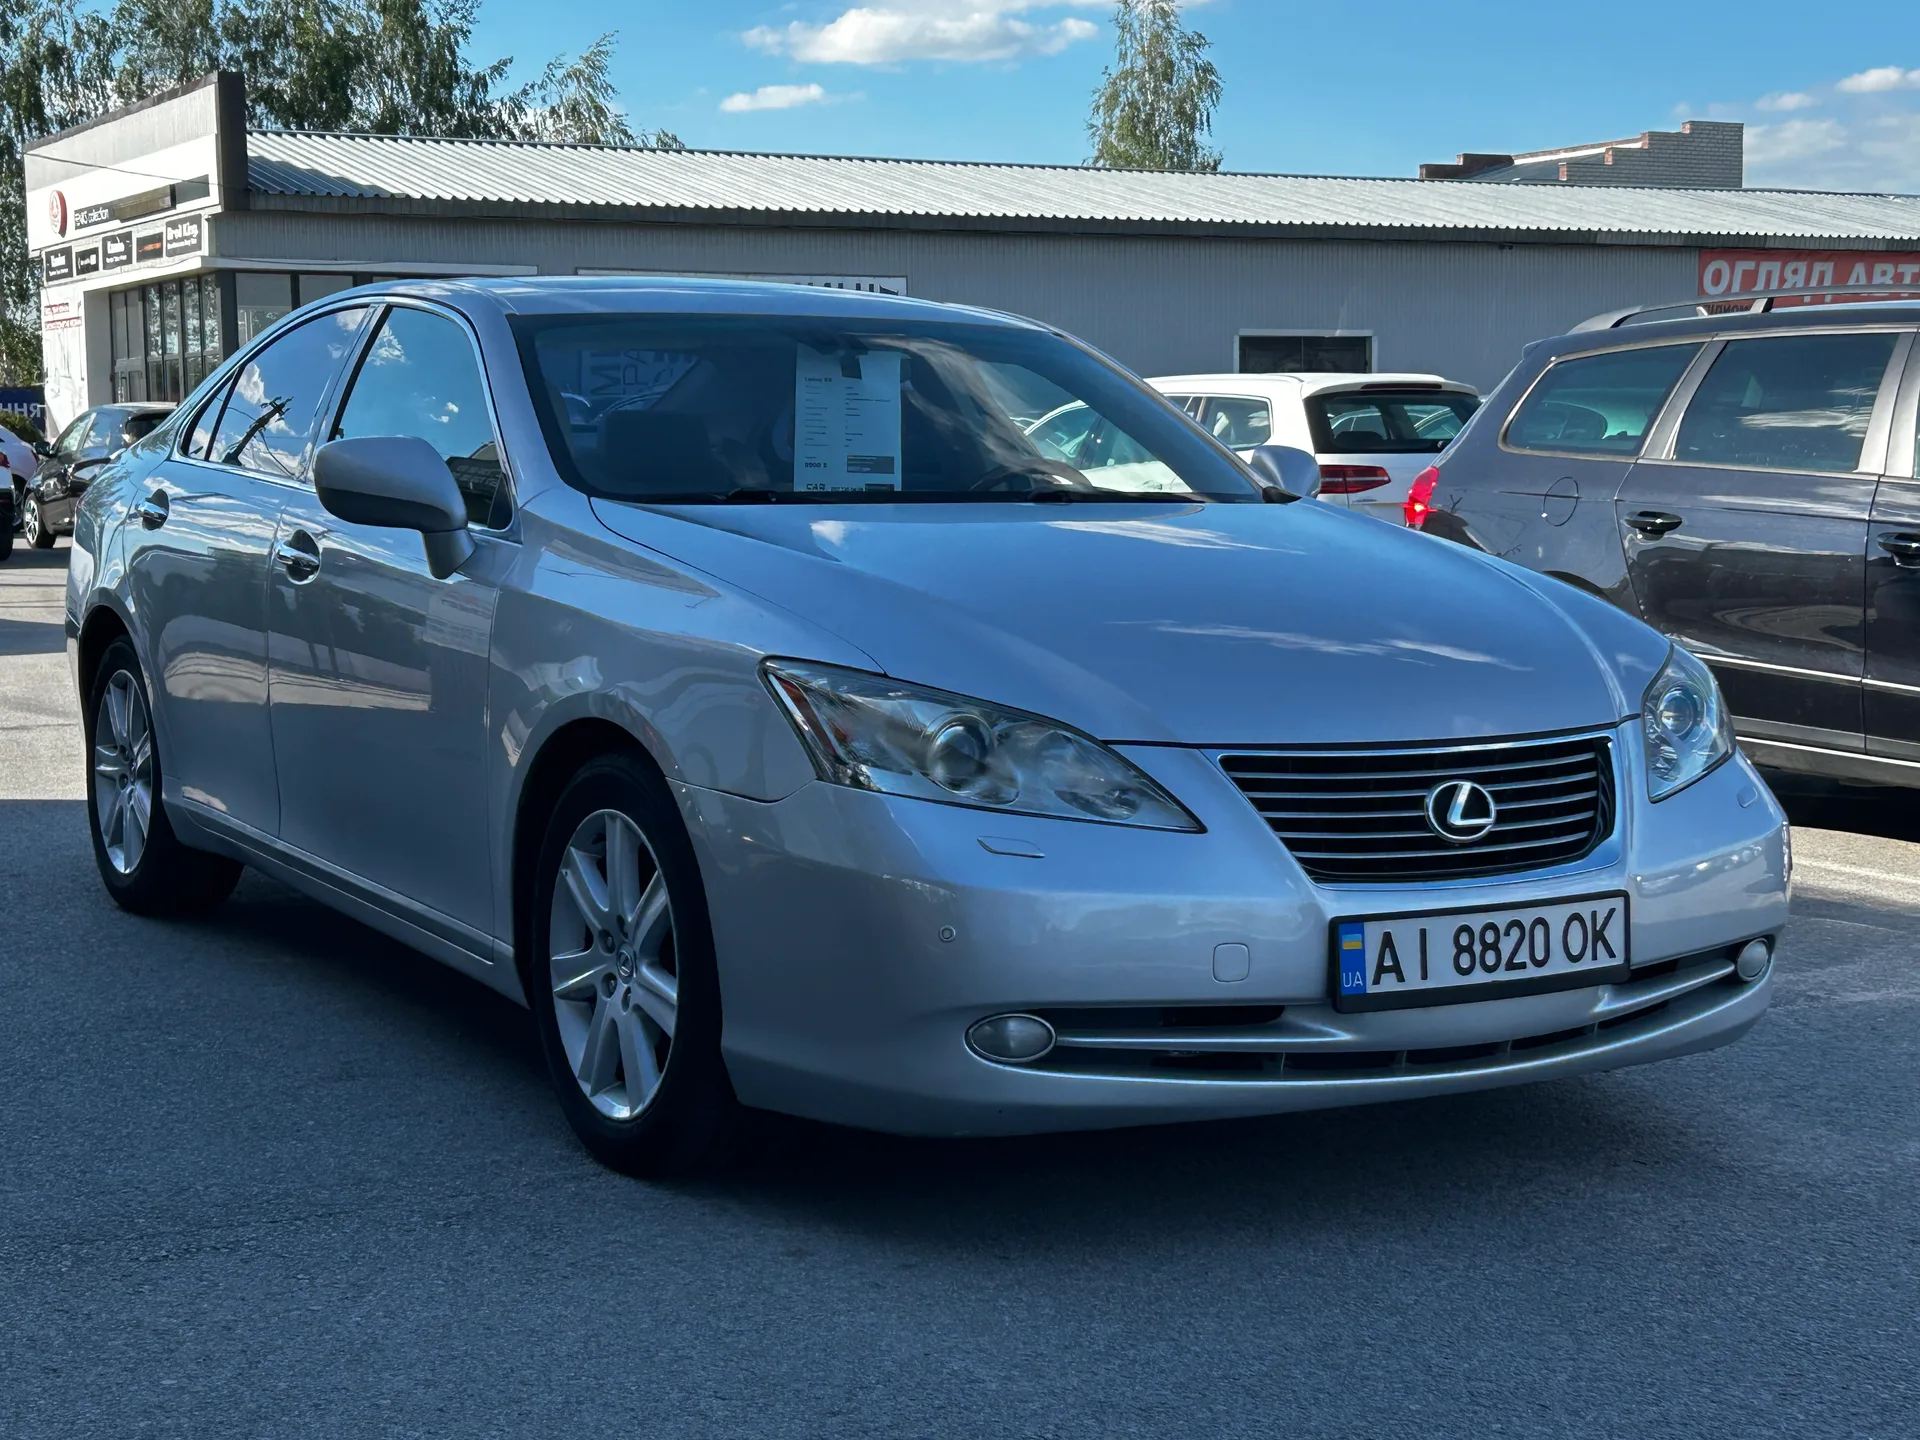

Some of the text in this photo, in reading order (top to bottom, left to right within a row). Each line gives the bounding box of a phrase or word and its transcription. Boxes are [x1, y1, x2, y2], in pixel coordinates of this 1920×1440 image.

[1845, 262, 1920, 297] АВТ
[1371, 907, 1617, 986] AI 8820 OK
[1343, 971, 1364, 989] UA
